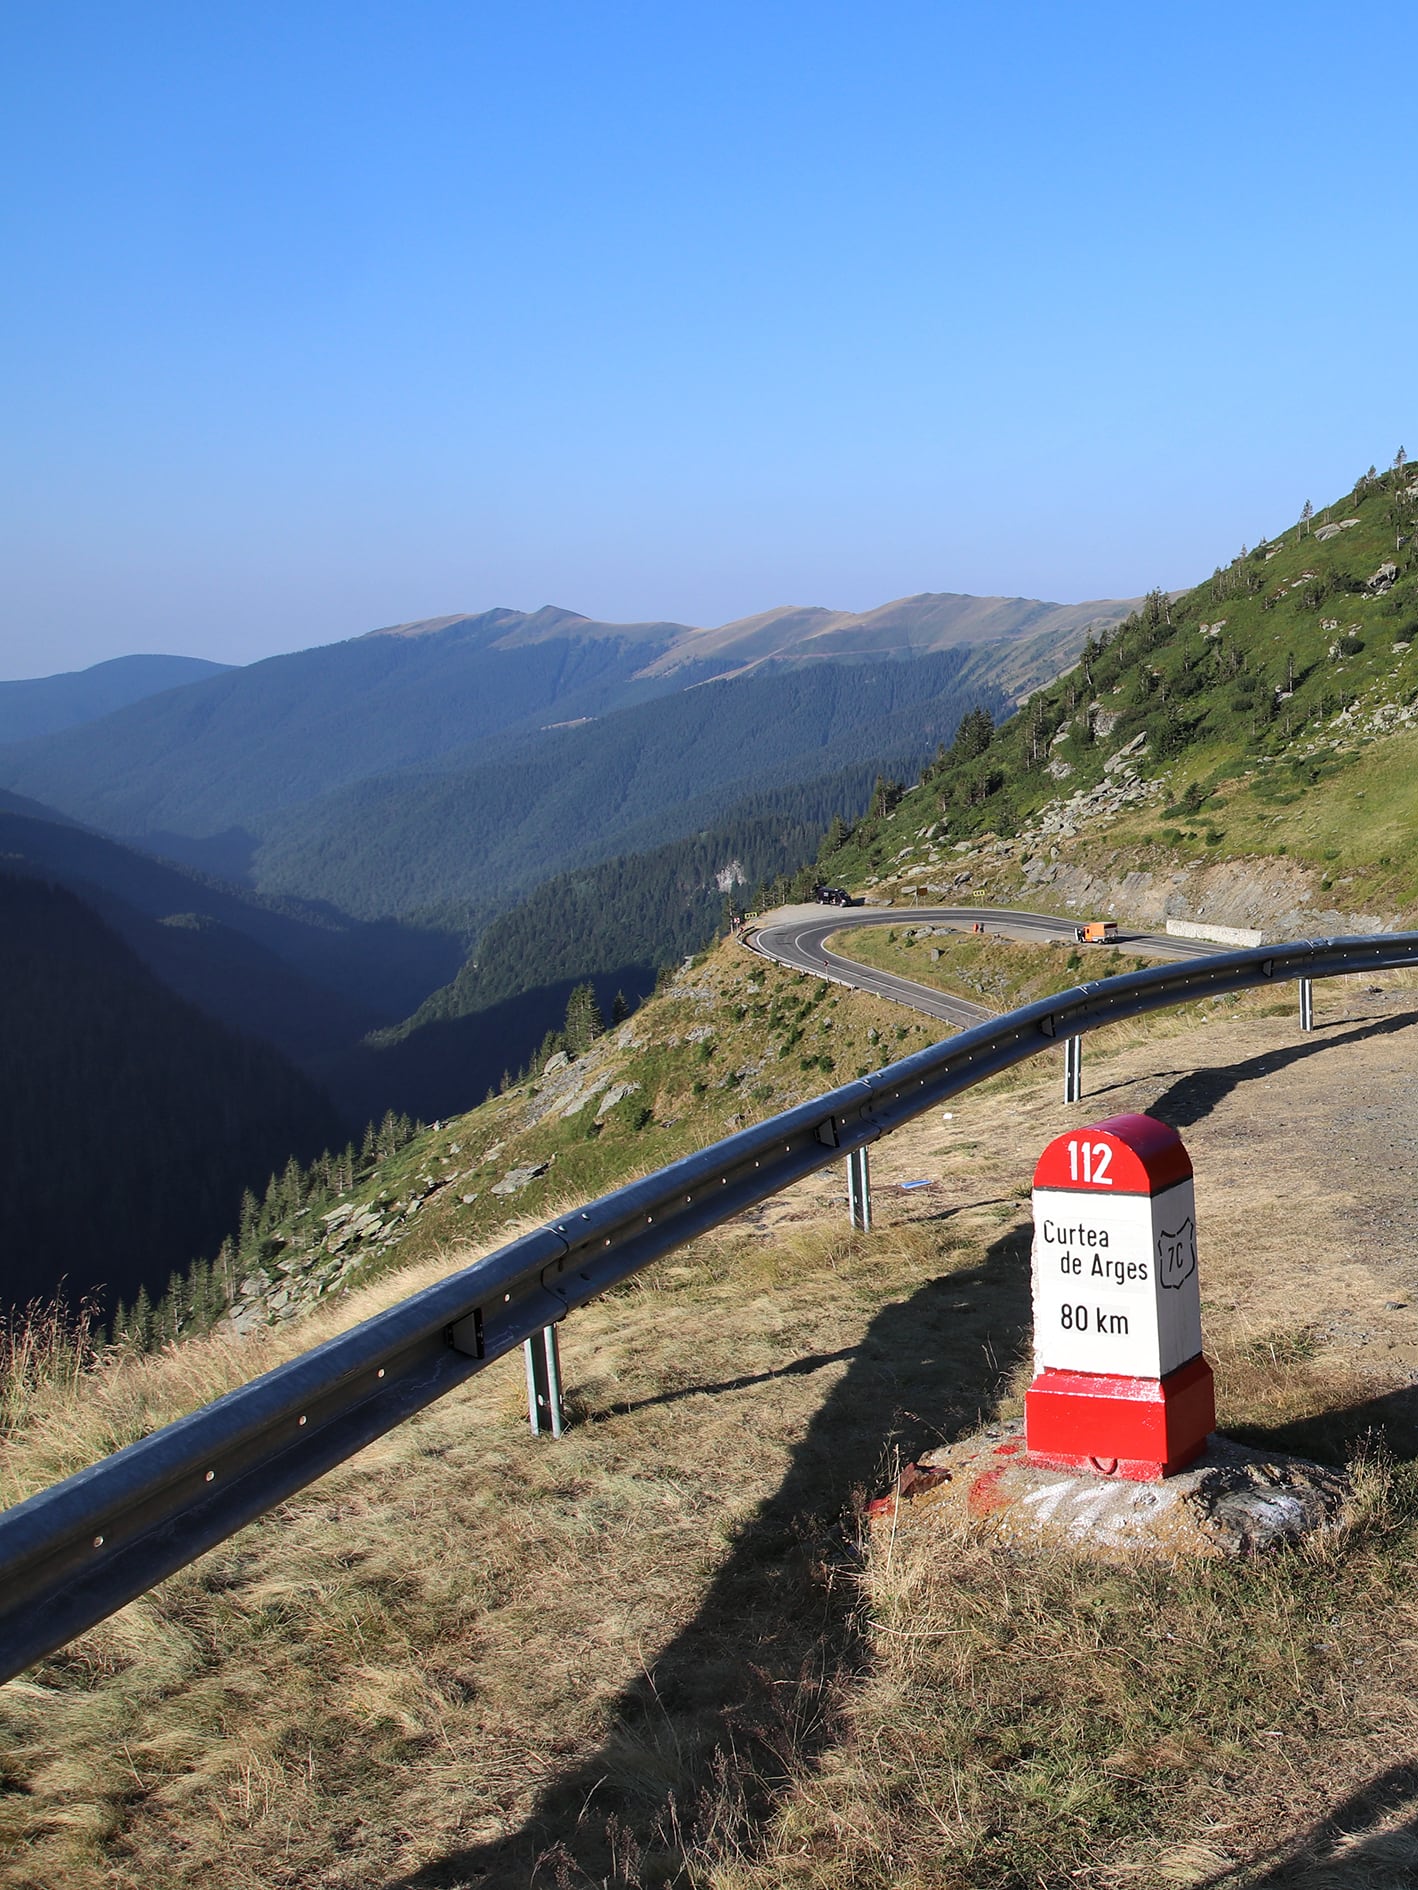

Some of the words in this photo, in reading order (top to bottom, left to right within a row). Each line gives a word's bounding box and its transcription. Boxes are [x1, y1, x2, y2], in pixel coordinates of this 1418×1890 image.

[1067, 1140, 1113, 1185] 112
[1043, 1219, 1109, 1248] Curtea
[1060, 1250, 1082, 1275] de
[1091, 1252, 1148, 1285] Arges
[1167, 1241, 1184, 1273] 7C
[1060, 1303, 1088, 1331] 80
[1096, 1306, 1129, 1335] km
